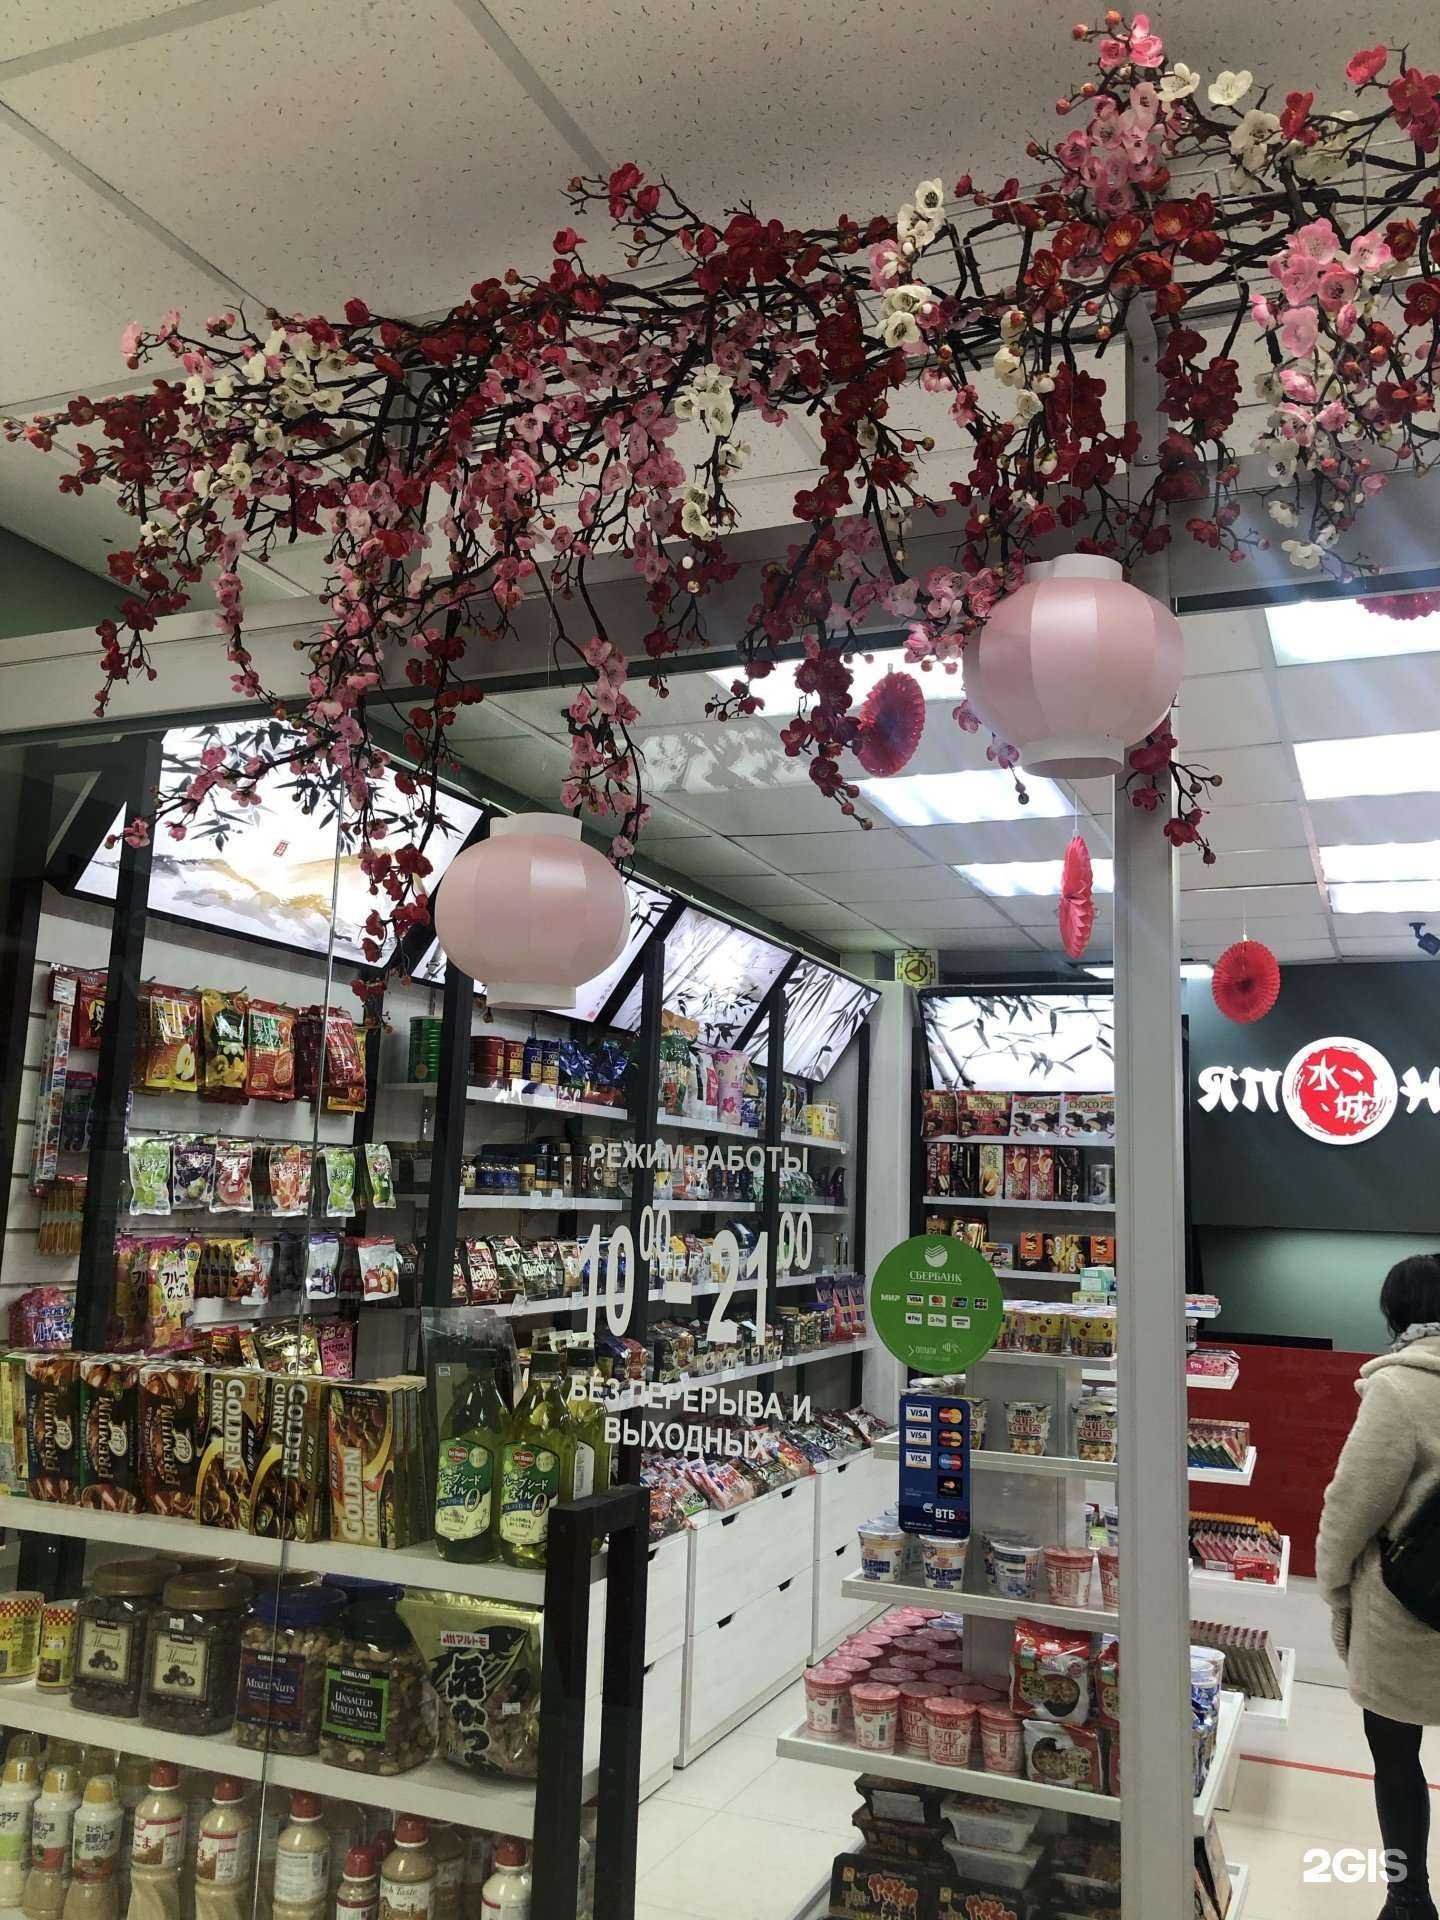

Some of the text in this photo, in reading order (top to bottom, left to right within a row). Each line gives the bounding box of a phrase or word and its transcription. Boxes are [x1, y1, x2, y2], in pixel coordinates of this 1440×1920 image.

[590, 1143, 809, 1174] РЕЖИМ РАБОТЫ
[707, 1230, 768, 1346] 21
[909, 1271, 962, 1282] СБЕРБАНК
[211, 1378, 224, 1433] CURRY
[224, 1379, 246, 1470] GOLDEN
[271, 1383, 286, 1440] CURRY
[570, 1375, 811, 1424] БЕЗ ПЕРЕРЫВА И
[911, 1409, 928, 1418] VISA
[44, 1391, 60, 1473] PREMIUM
[98, 1396, 114, 1479] PREMIUM
[160, 1403, 180, 1486] PREMIUM
[282, 1384, 308, 1478] GOLDEN
[604, 1416, 771, 1461] ВЫХОДНЫХ
[911, 1431, 927, 1440] VISA
[911, 1454, 927, 1463] VISA
[342, 1447, 363, 1539] GOLDEN
[935, 1508, 955, 1520] ВТБ
[342, 1669, 370, 1680] KIRKLAND
